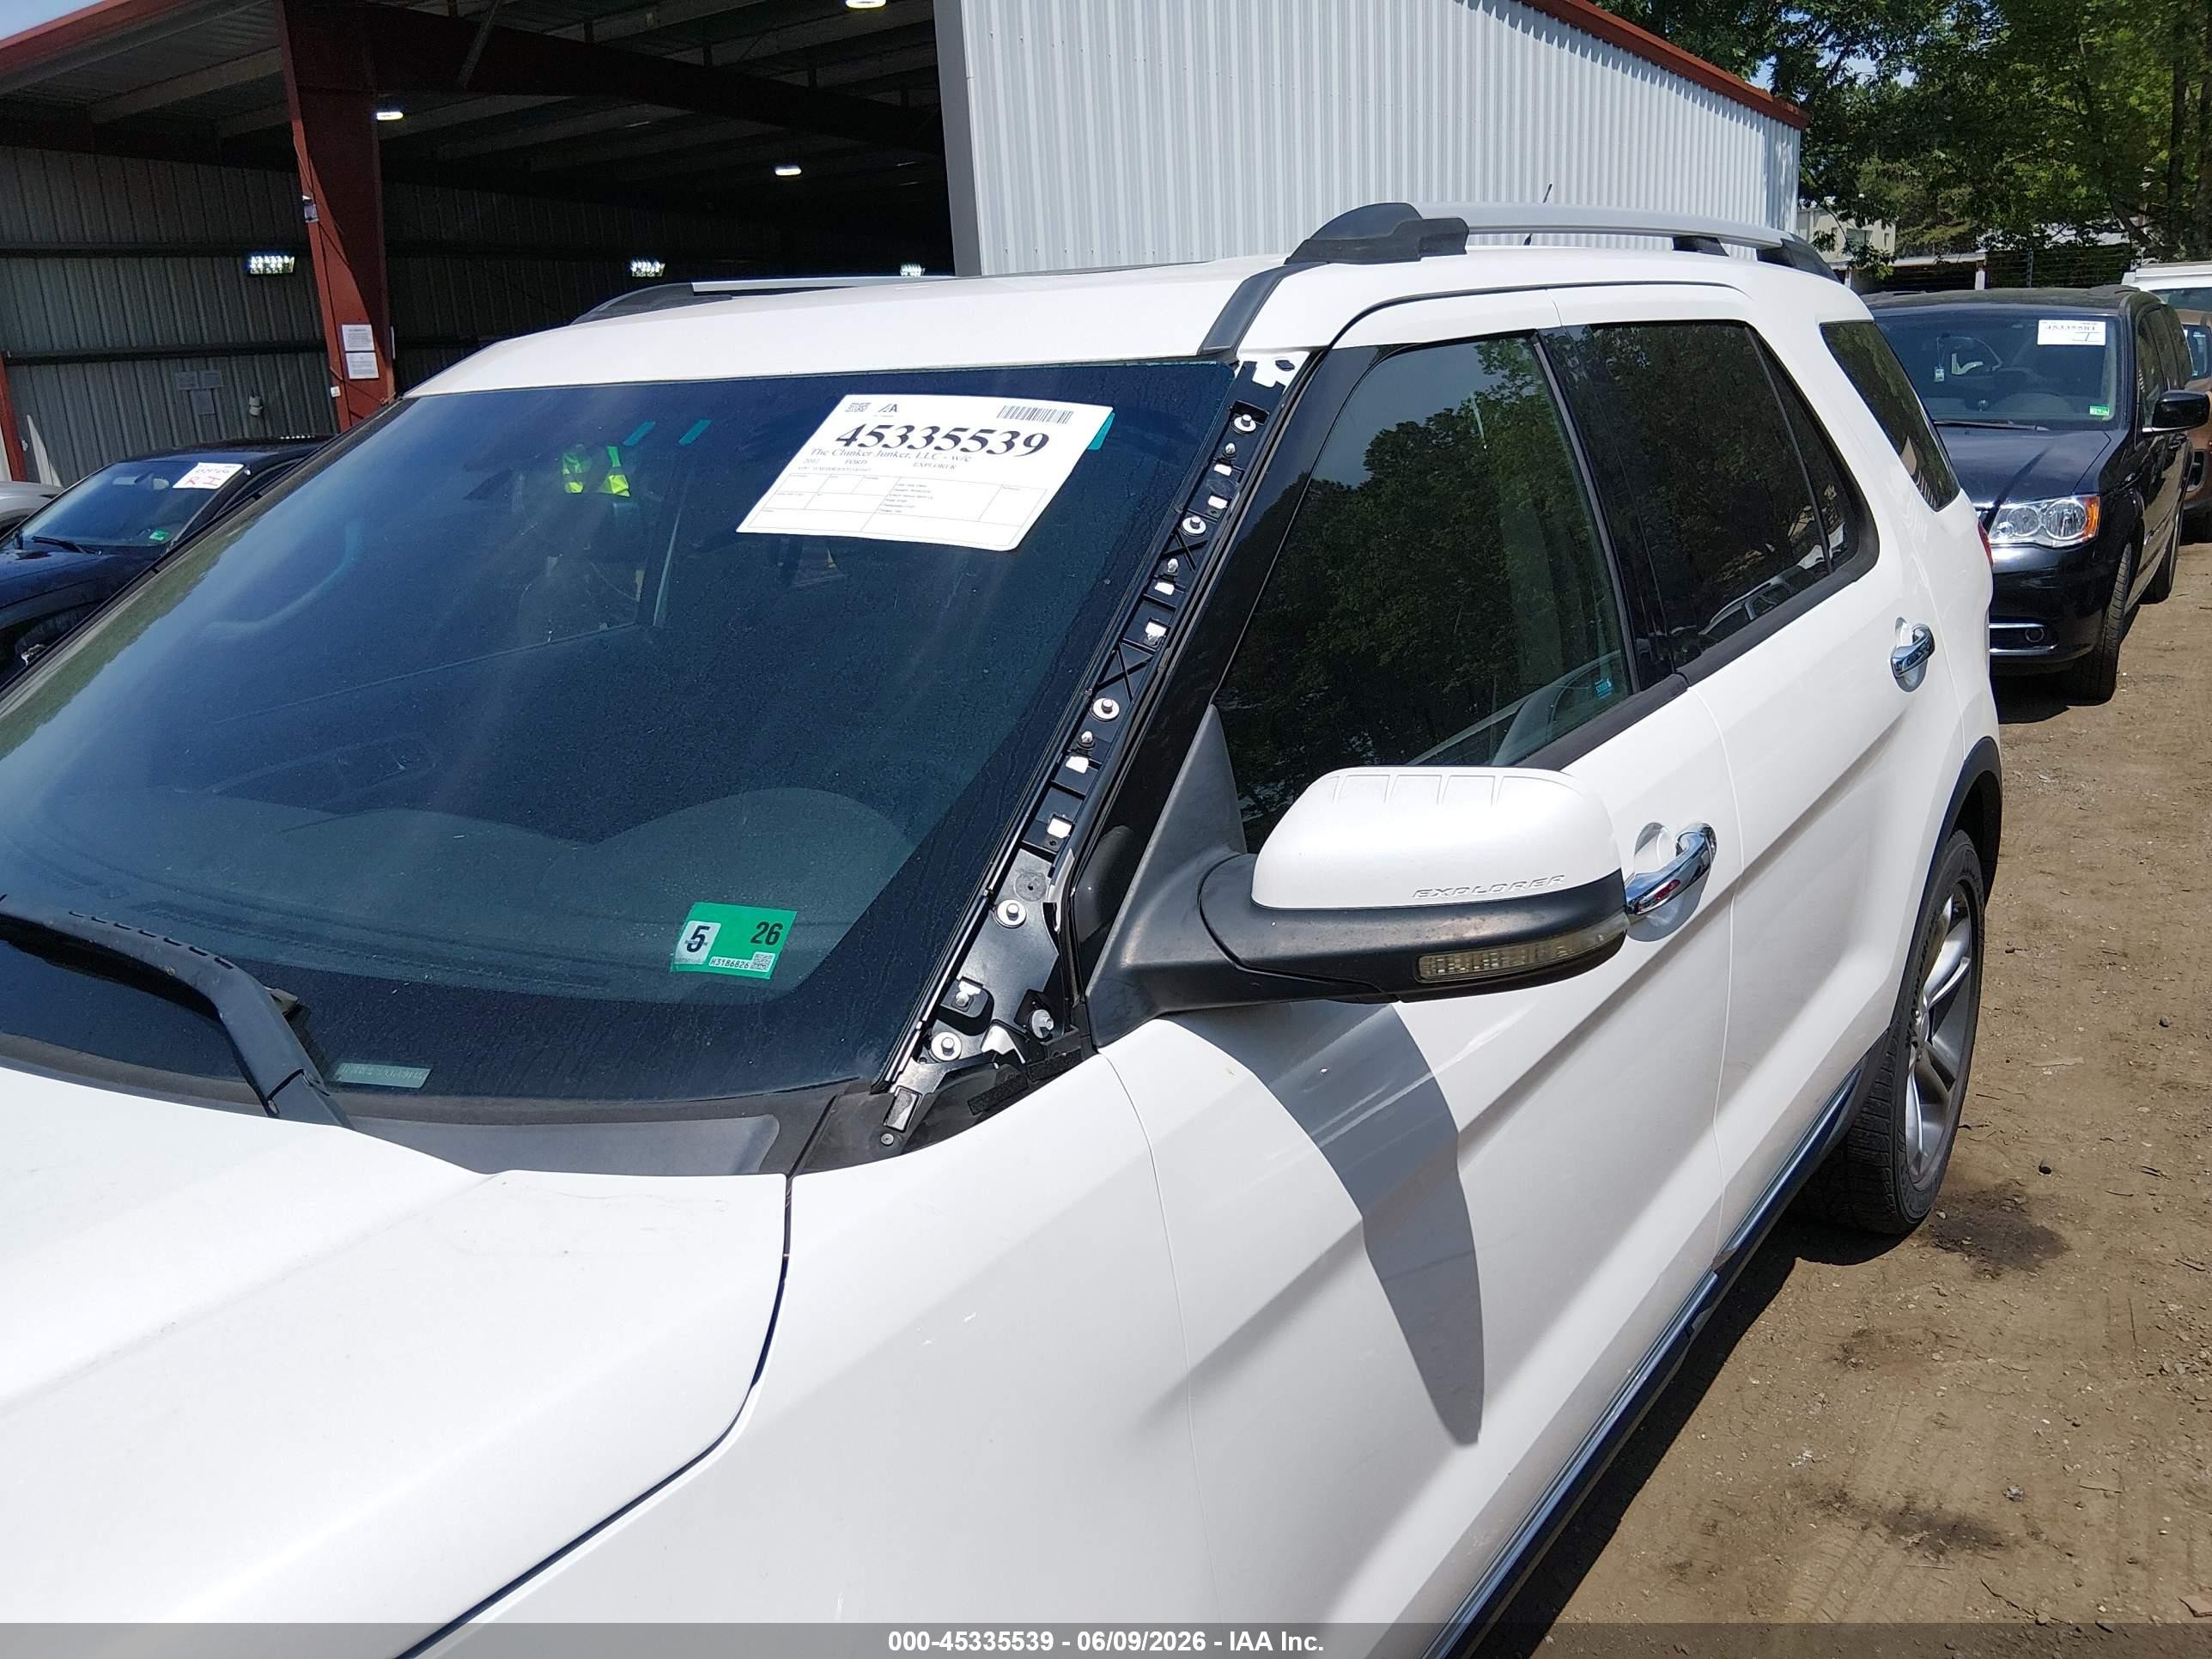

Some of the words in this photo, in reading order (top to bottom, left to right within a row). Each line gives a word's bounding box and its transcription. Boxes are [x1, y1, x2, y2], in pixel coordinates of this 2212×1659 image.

[836, 423, 1049, 458] 45335539
[811, 447, 830, 457] The
[832, 447, 872, 458] Clunker
[874, 449, 912, 459] Junker,
[915, 452, 943, 461] LLC
[1413, 874, 1566, 899] EXPLORER
[687, 925, 711, 953] 5
[750, 921, 784, 946] 26
[710, 957, 750, 969] H3186826
